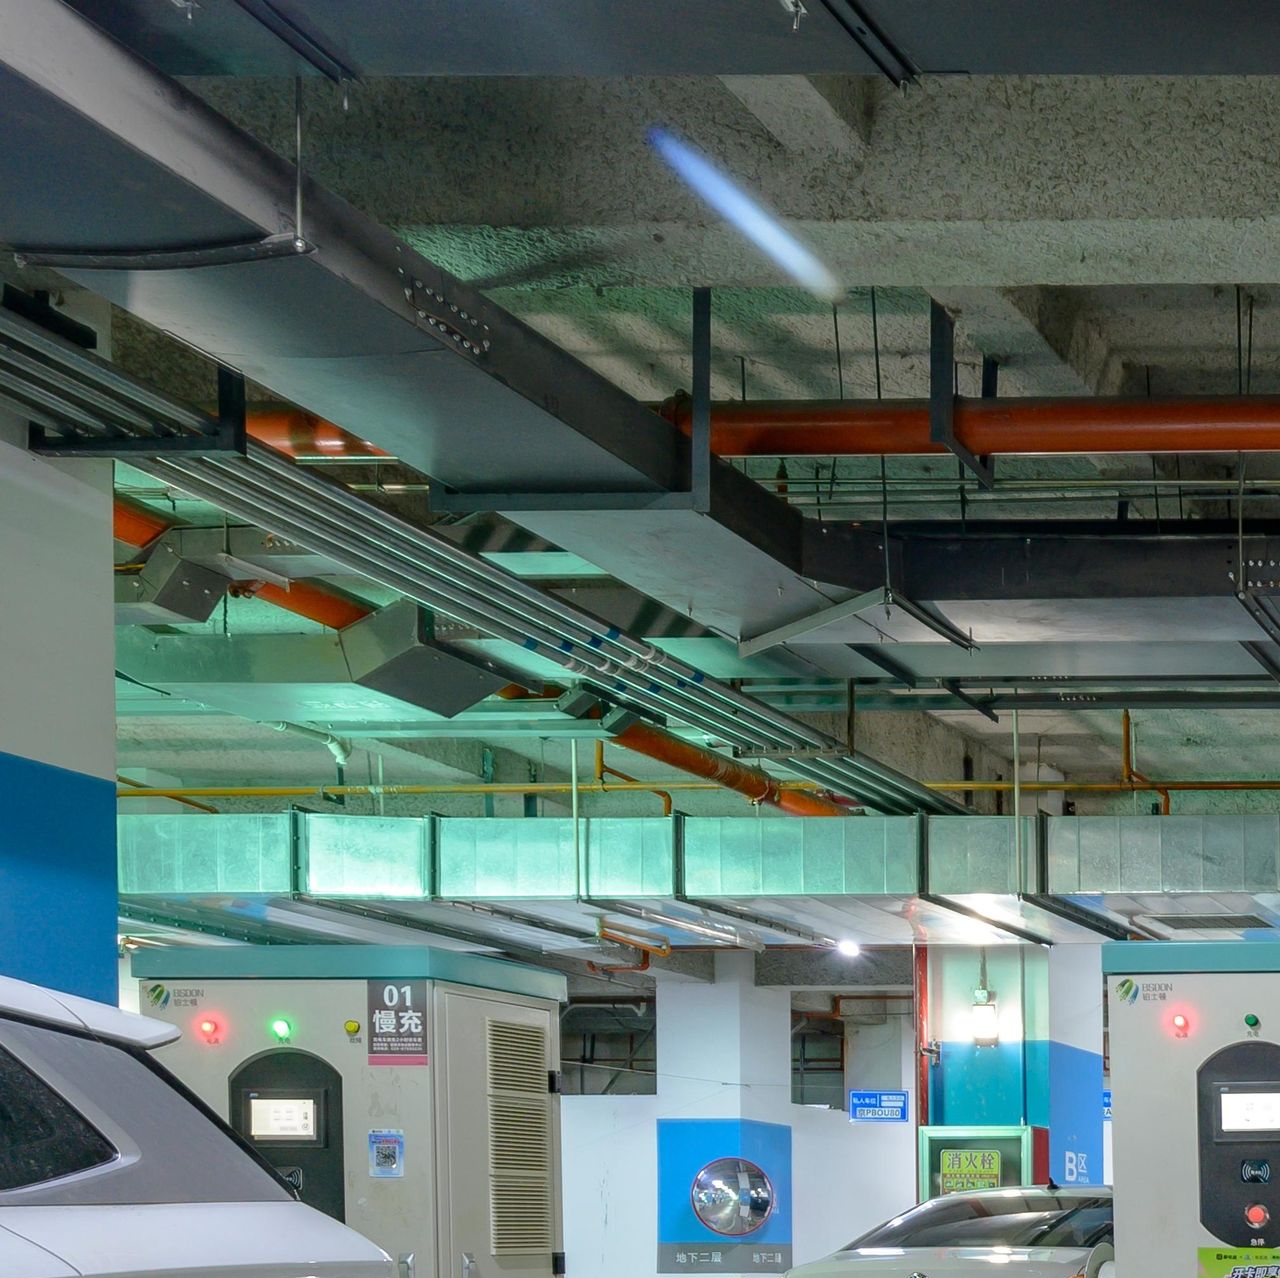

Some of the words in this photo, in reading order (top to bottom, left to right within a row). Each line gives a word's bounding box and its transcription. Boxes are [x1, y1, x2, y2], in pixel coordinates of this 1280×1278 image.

[384, 985, 411, 1006] 01
[373, 1010, 422, 1033] 慢充
[947, 1152, 995, 1169] 消火栓
[676, 1252, 721, 1263] 地下二层
